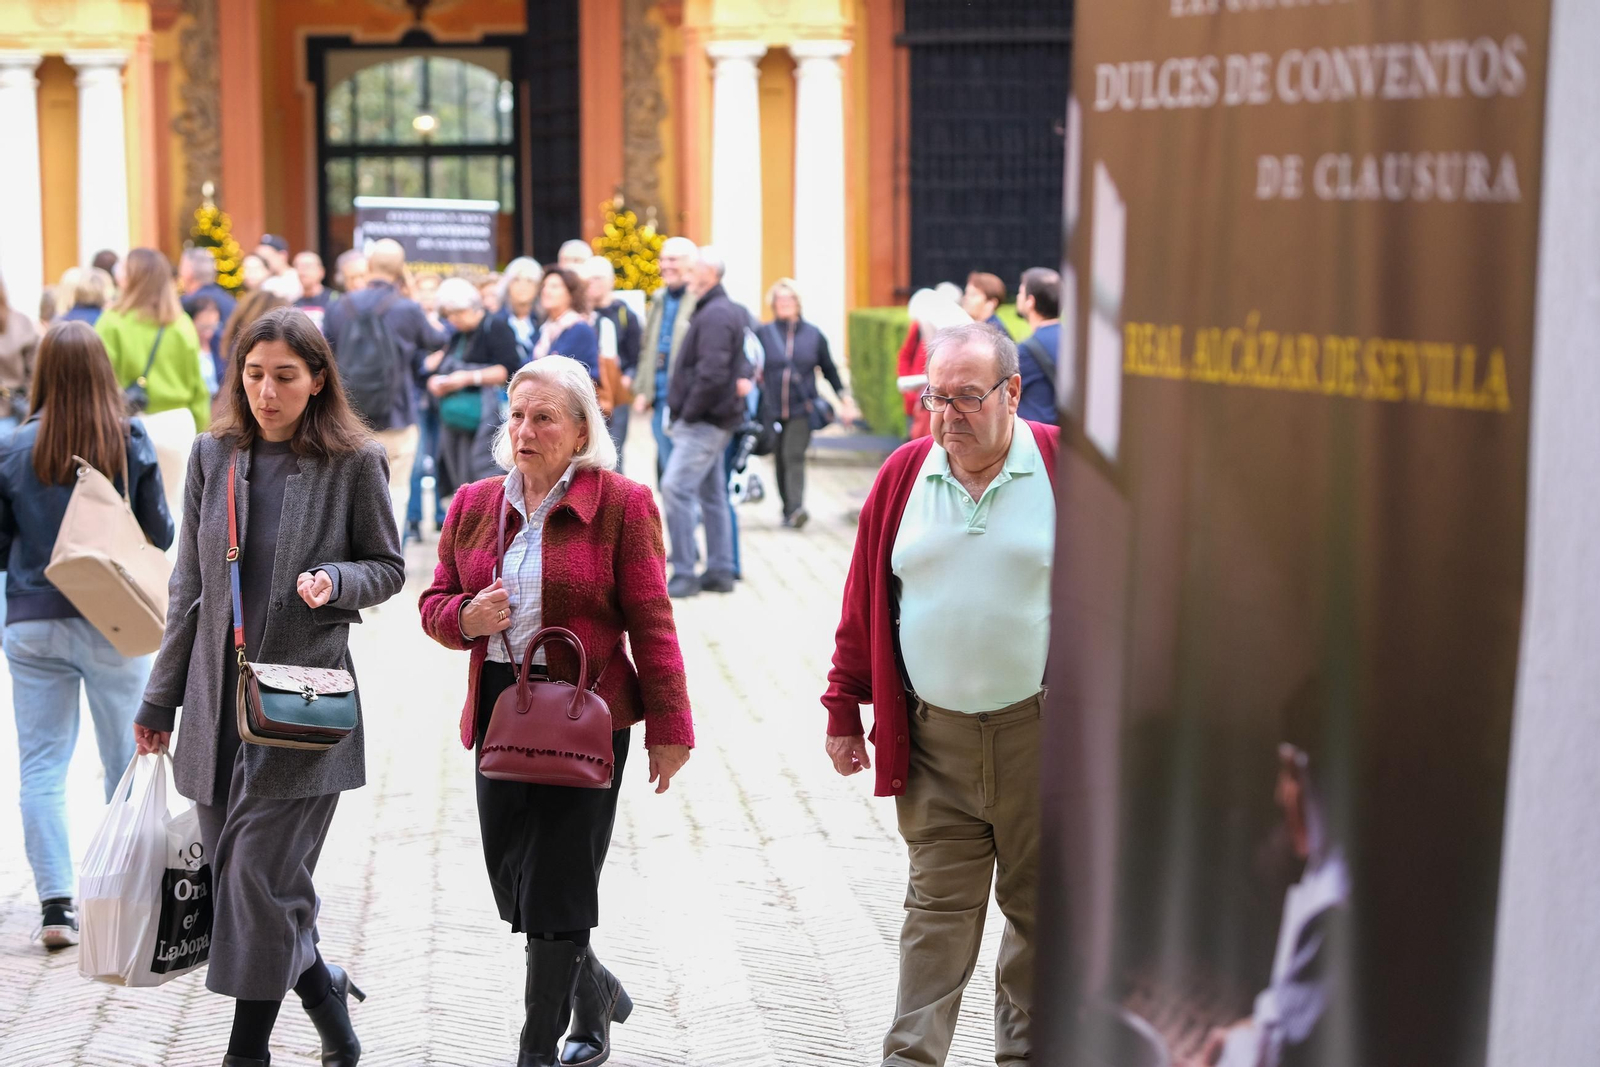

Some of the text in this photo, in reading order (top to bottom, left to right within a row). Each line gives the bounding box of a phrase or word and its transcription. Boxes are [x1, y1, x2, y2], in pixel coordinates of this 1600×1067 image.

[1095, 33, 1527, 111] DULCES DE CONVENTOS
[1256, 151, 1521, 202] DE CLAUSURA
[1123, 309, 1511, 412] REAL ALCÁZAR DE SEVILLA
[174, 879, 207, 901] Ora
[183, 909, 199, 930] et
[157, 934, 210, 961] Labora
